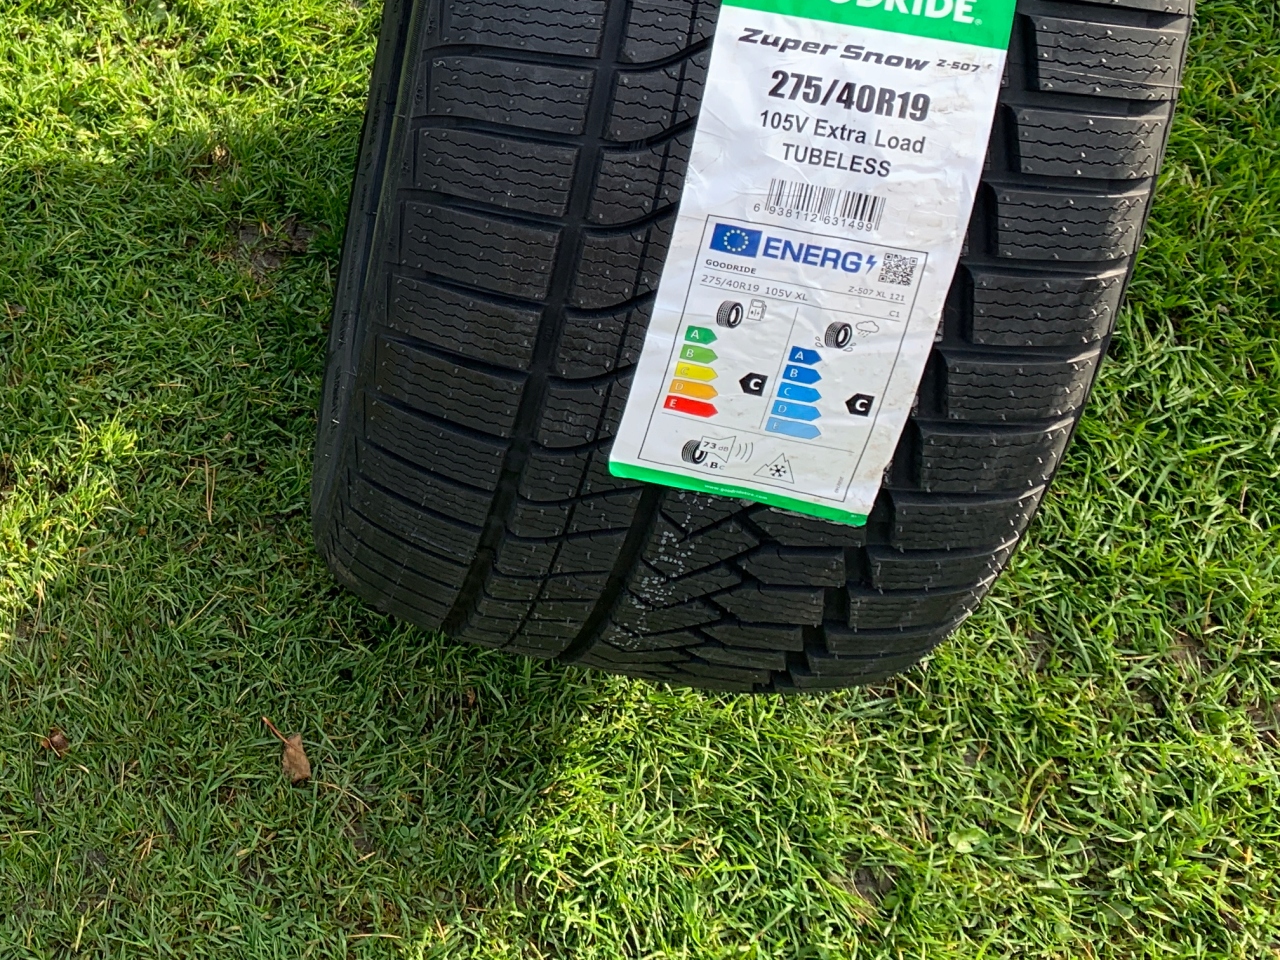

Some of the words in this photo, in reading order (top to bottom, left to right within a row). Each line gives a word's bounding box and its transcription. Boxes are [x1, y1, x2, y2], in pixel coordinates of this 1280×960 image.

[737, 27, 838, 58] Zuper
[839, 43, 931, 71] Snow
[936, 59, 980, 72] Z-507
[768, 69, 932, 122] 275/40R19
[759, 110, 810, 134] 105V
[813, 119, 867, 145] Extra
[874, 129, 926, 154] Load
[782, 142, 892, 178] TUBELESS
[753, 204, 761, 213] 6
[769, 205, 818, 223] 938112
[823, 215, 873, 232] 631499
[762, 236, 863, 274] ENERG
[705, 258, 757, 275] GOODRIDE
[701, 274, 760, 292] 275/40R19
[765, 287, 792, 299] 105V
[794, 292, 808, 301] XL
[848, 285, 873, 296] Z-507
[875, 290, 888, 299] XL
[890, 293, 905, 302] 121
[889, 310, 900, 318] C1
[690, 329, 699, 339] A
[686, 349, 694, 358] B
[795, 351, 804, 360] A
[681, 367, 690, 376] C
[789, 368, 798, 378] B
[675, 383, 684, 391] D
[749, 378, 762, 391] C
[784, 387, 792, 396] C
[669, 398, 677, 407] E
[855, 399, 868, 411] C
[778, 404, 787, 413] D
[702, 441, 717, 450] 73
[709, 461, 718, 469] B
